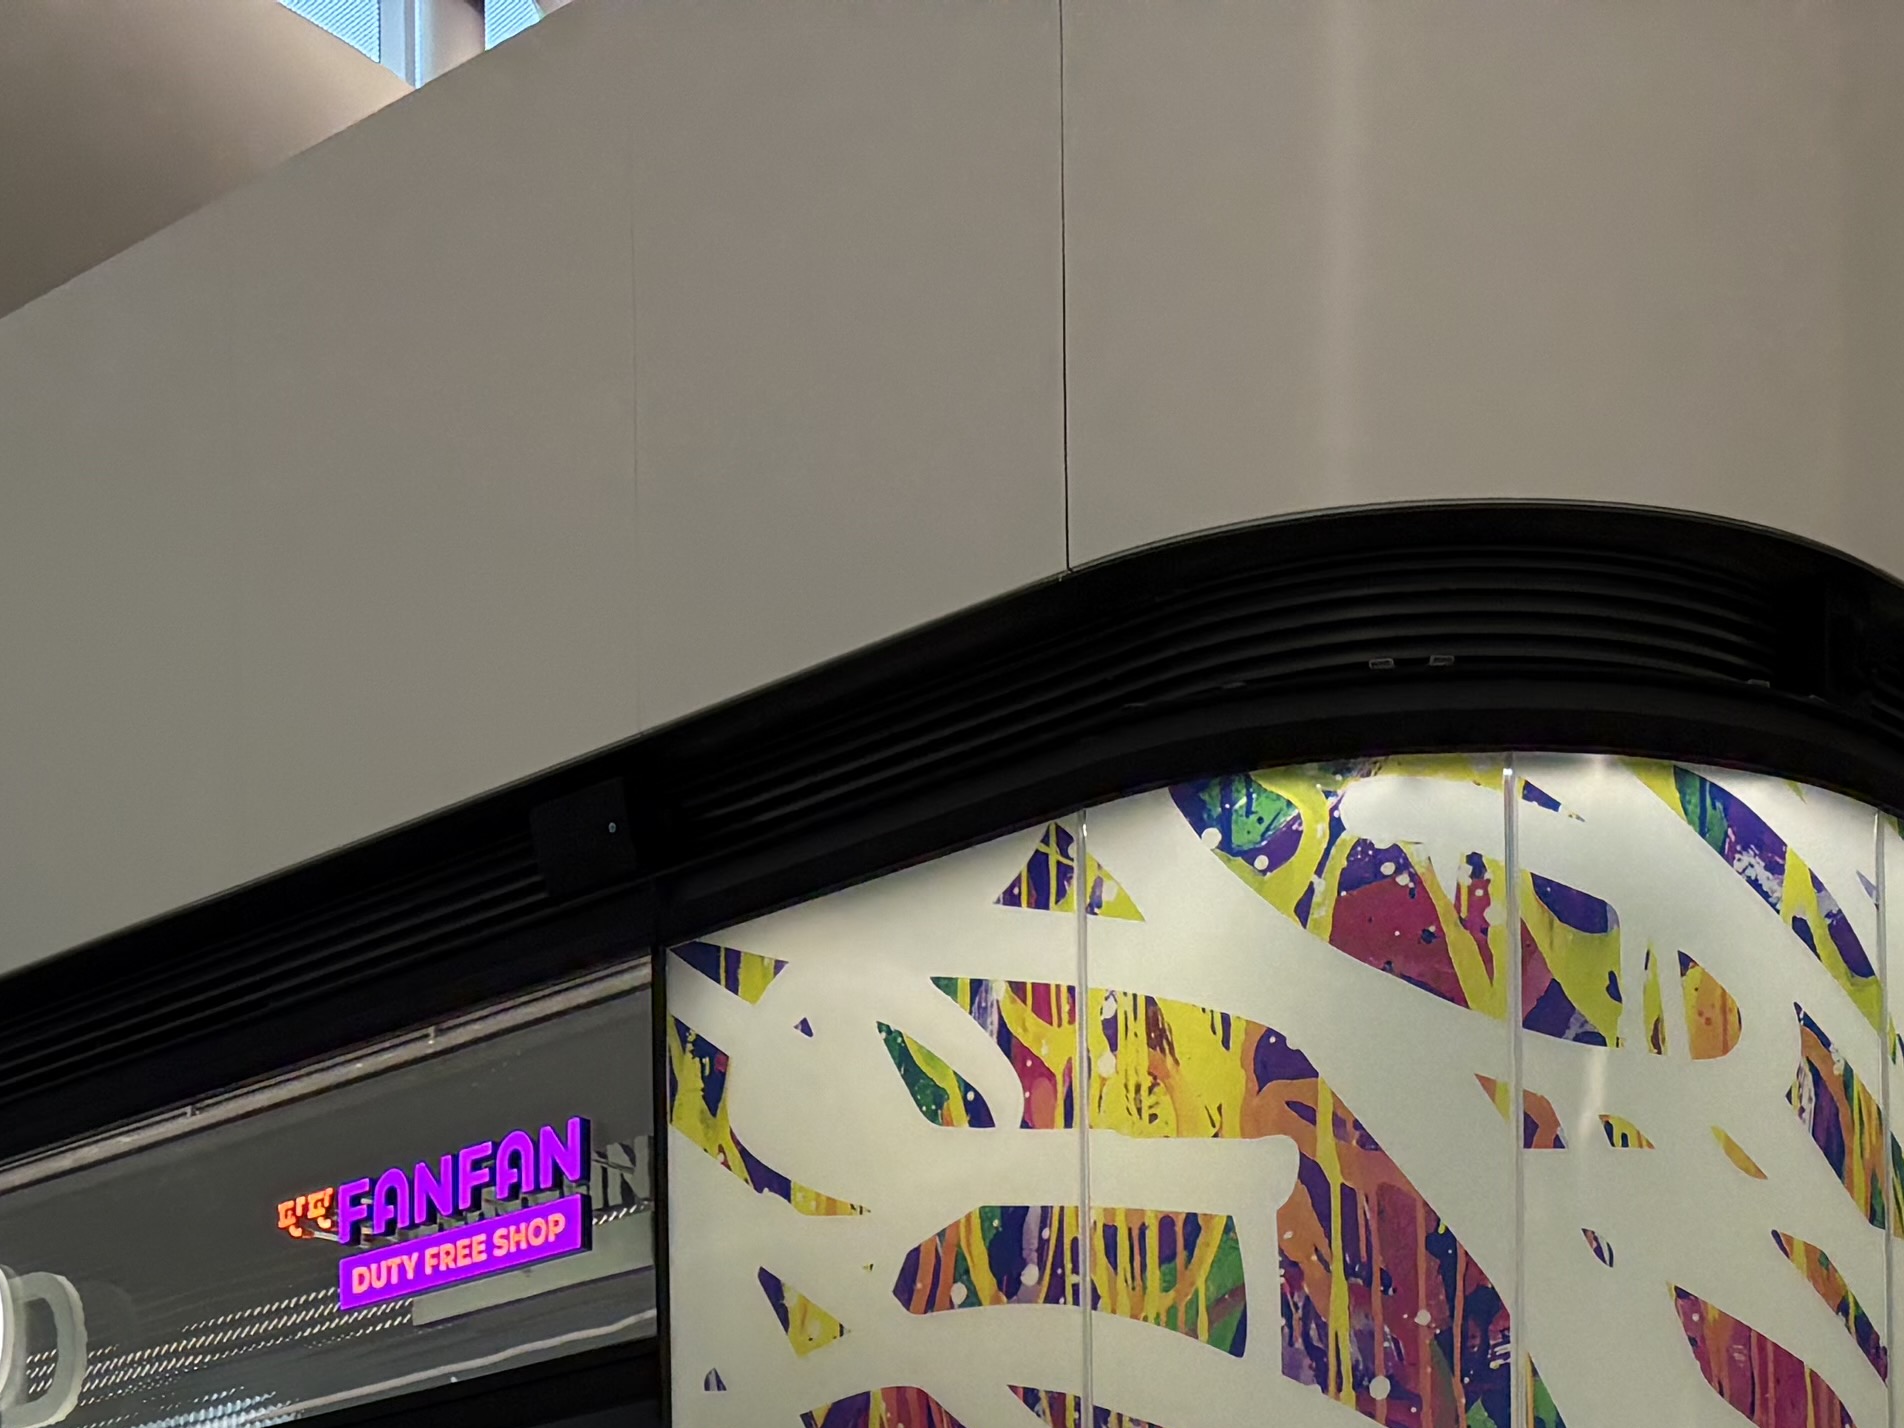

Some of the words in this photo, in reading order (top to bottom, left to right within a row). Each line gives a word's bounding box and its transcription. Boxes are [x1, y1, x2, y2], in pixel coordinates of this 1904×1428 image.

[338, 1116, 588, 1245] FANFAN
[351, 1252, 418, 1294] DUTY
[424, 1240, 487, 1276] FREE
[493, 1213, 565, 1257] SHOP
